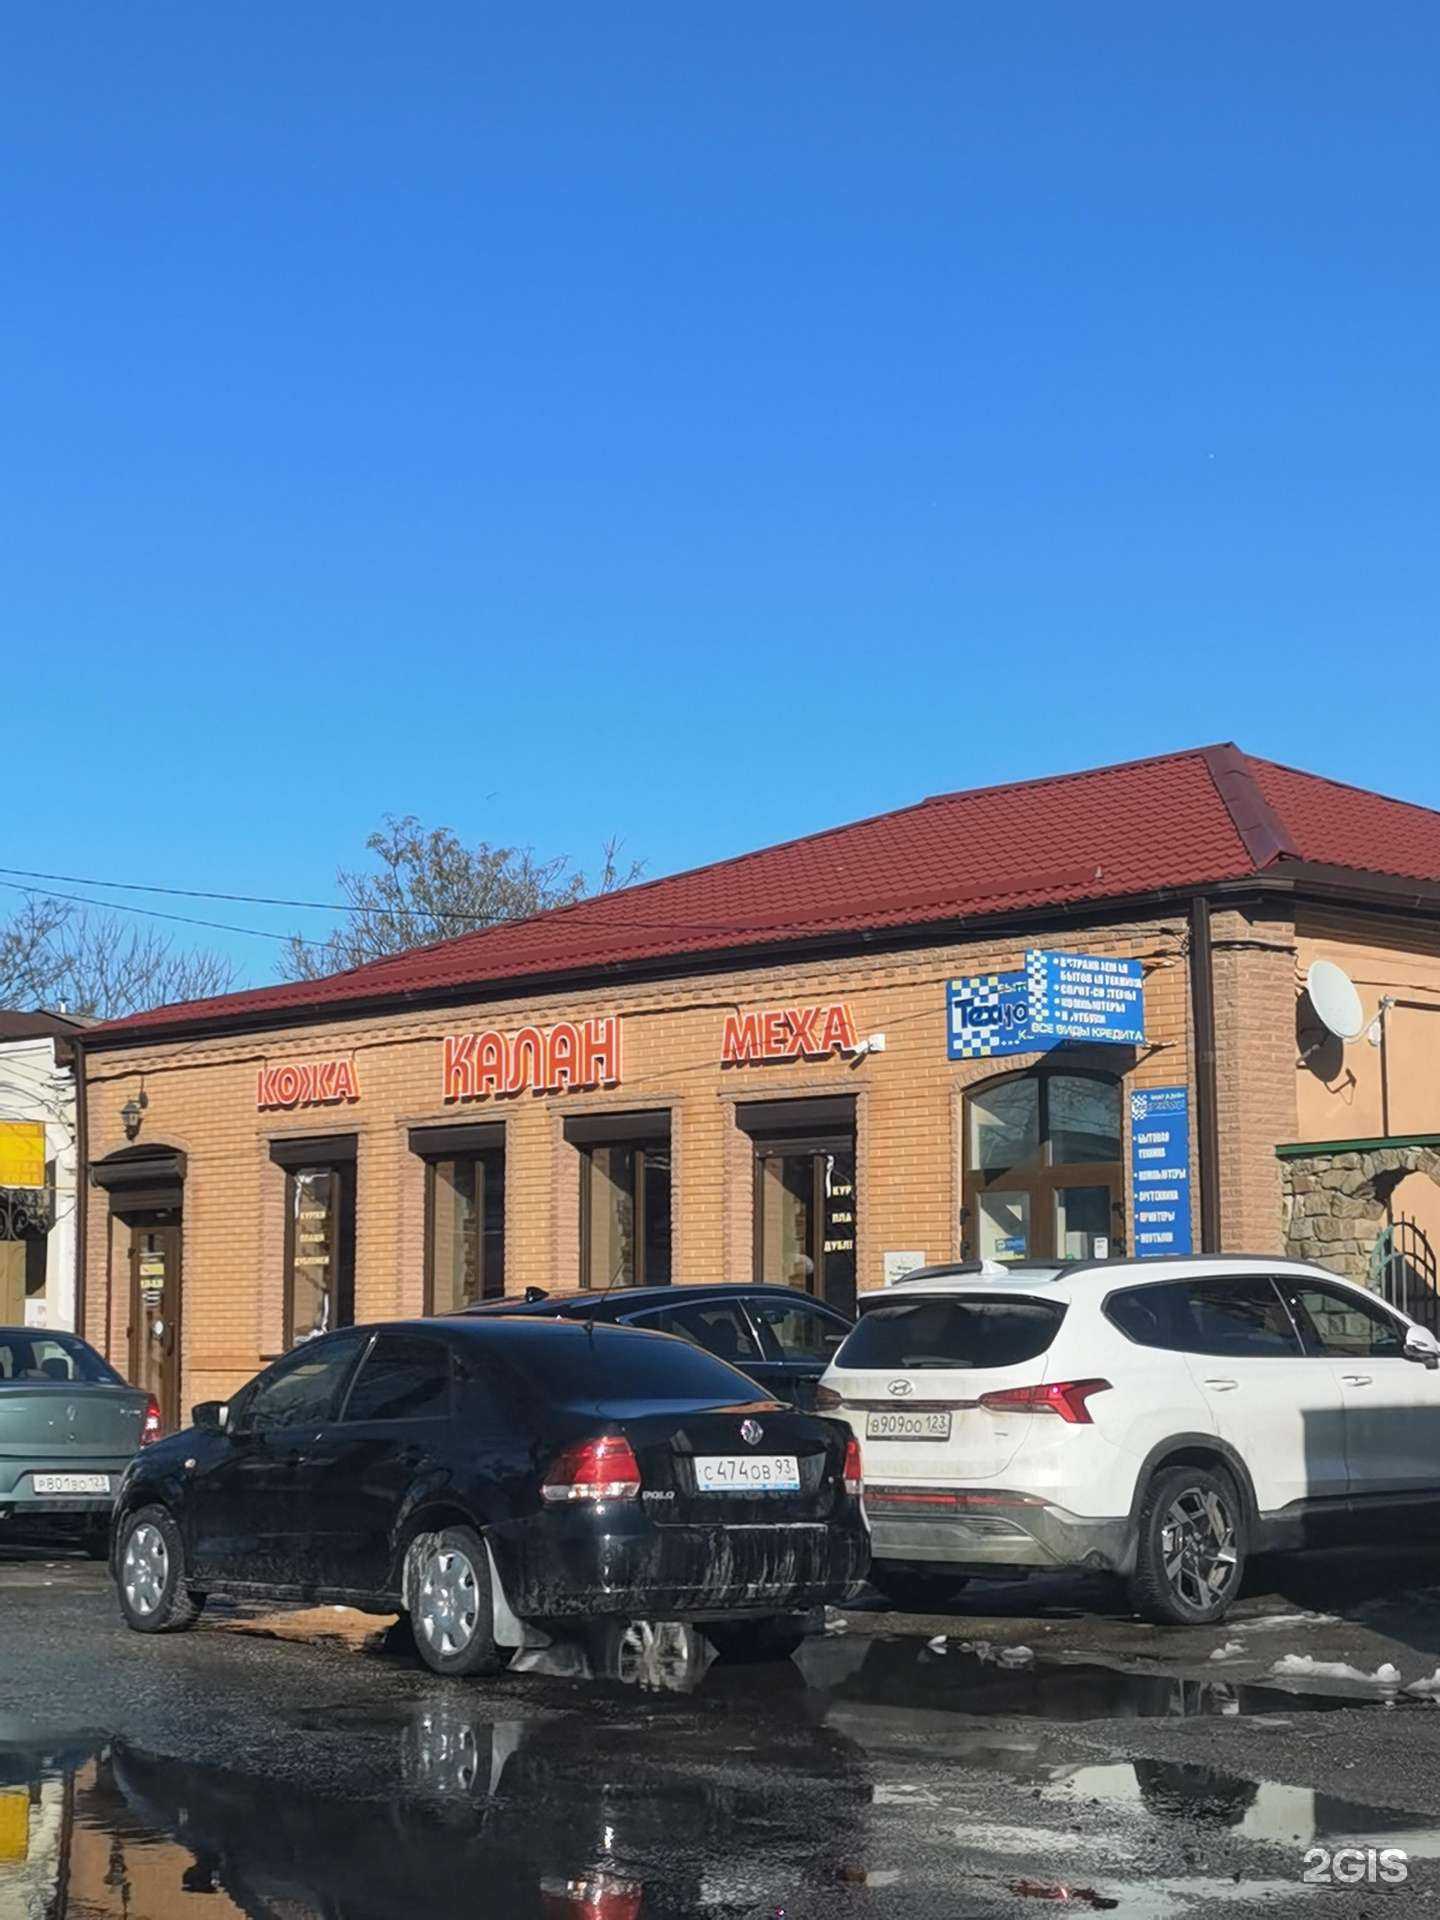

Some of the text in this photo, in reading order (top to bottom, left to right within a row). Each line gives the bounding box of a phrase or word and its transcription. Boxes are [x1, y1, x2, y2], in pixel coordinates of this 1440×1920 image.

[443, 1016, 622, 1103] КАЛАН
[720, 1004, 860, 1066] МЕХА
[257, 1059, 361, 1110] КОЖА
